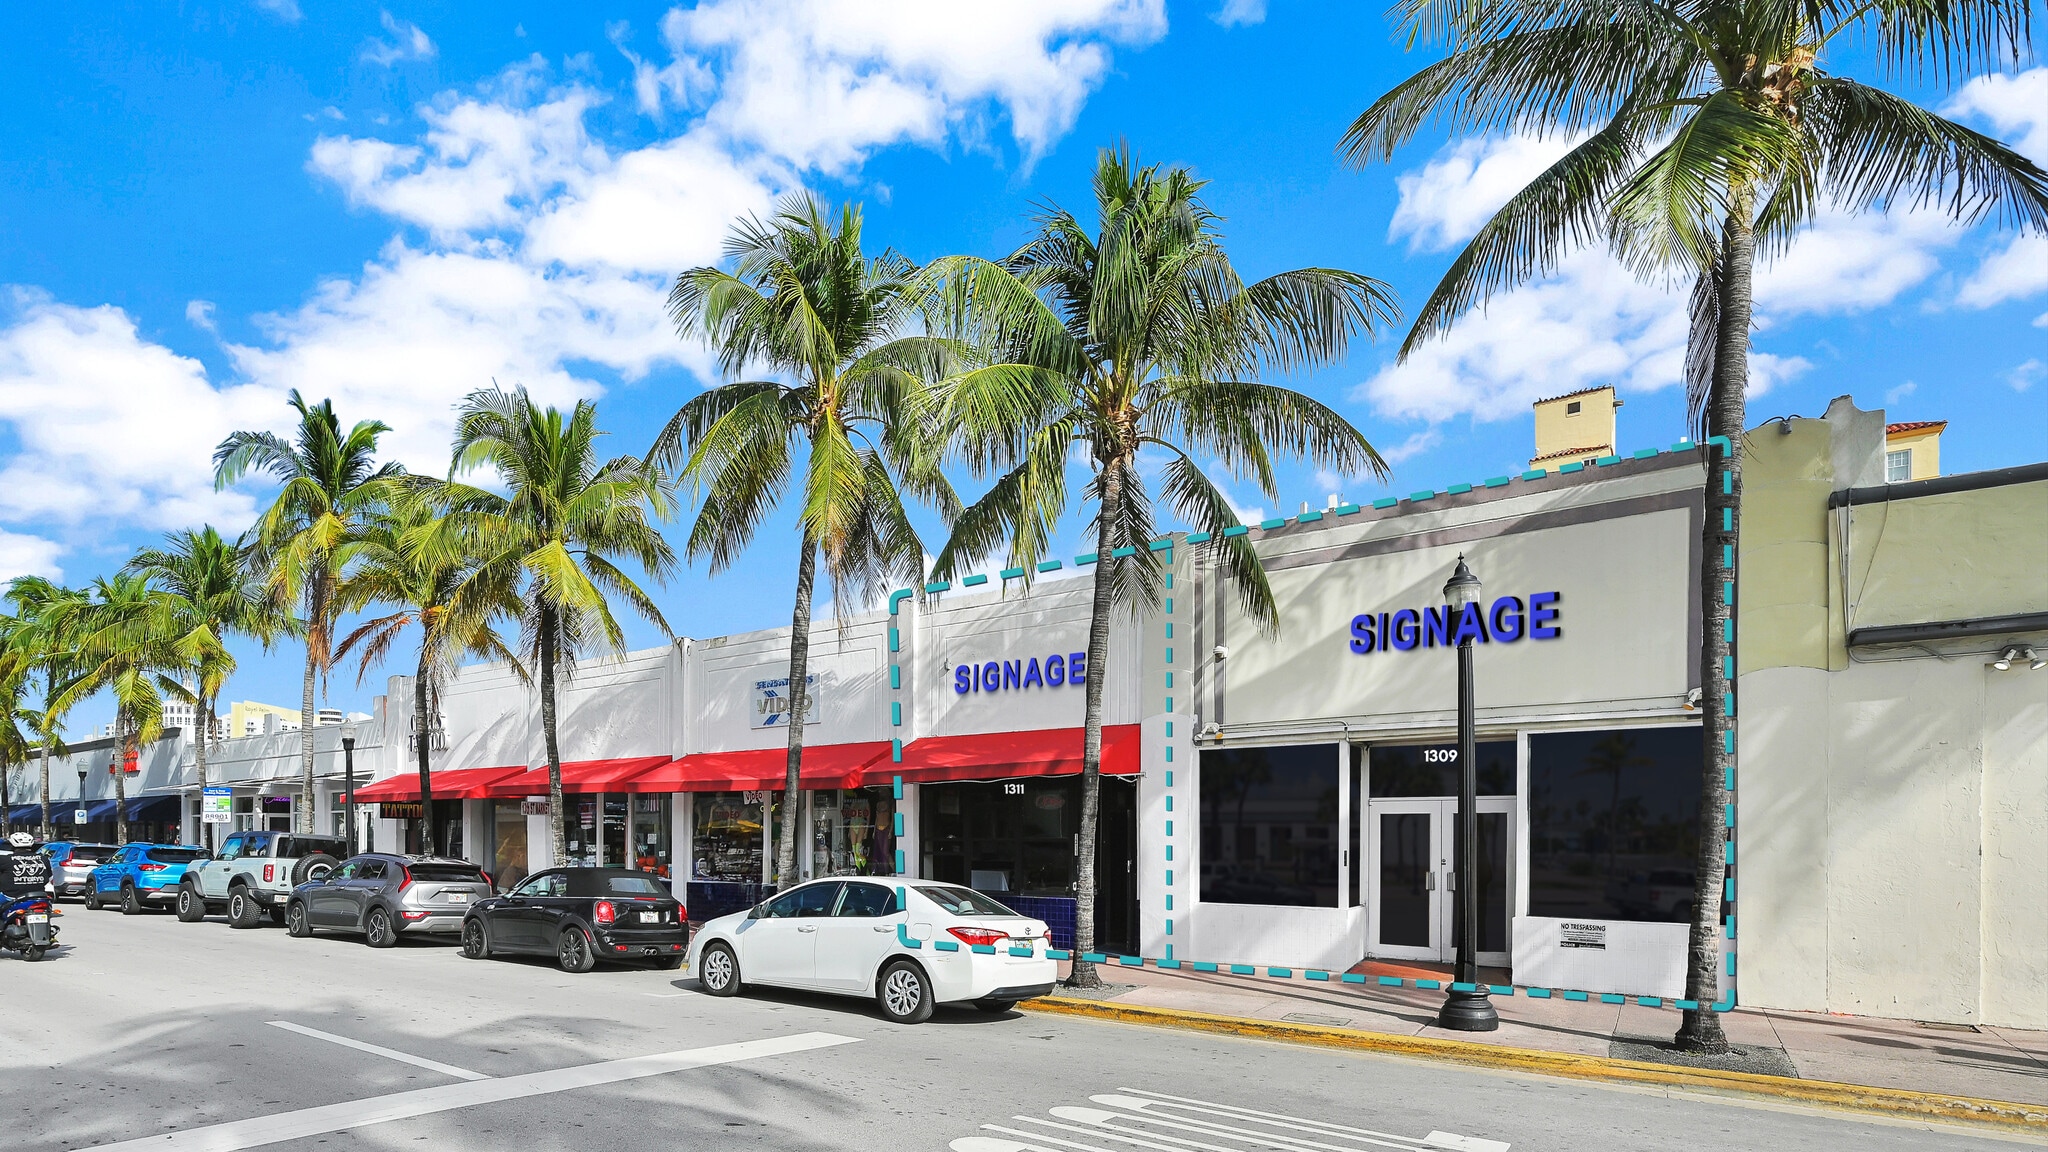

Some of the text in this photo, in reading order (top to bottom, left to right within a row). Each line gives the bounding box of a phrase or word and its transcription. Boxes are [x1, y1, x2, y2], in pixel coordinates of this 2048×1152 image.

[1350, 591, 1560, 654] SIGNAGE
[954, 652, 1087, 695] SIGNAGE
[755, 675, 814, 690] SENSATS
[756, 694, 813, 715] VIDO
[1423, 749, 1458, 763] 1309
[1004, 783, 1025, 795] 1311
[745, 792, 763, 801] VIDEO
[1560, 922, 1606, 932] NO TRESPASSING
